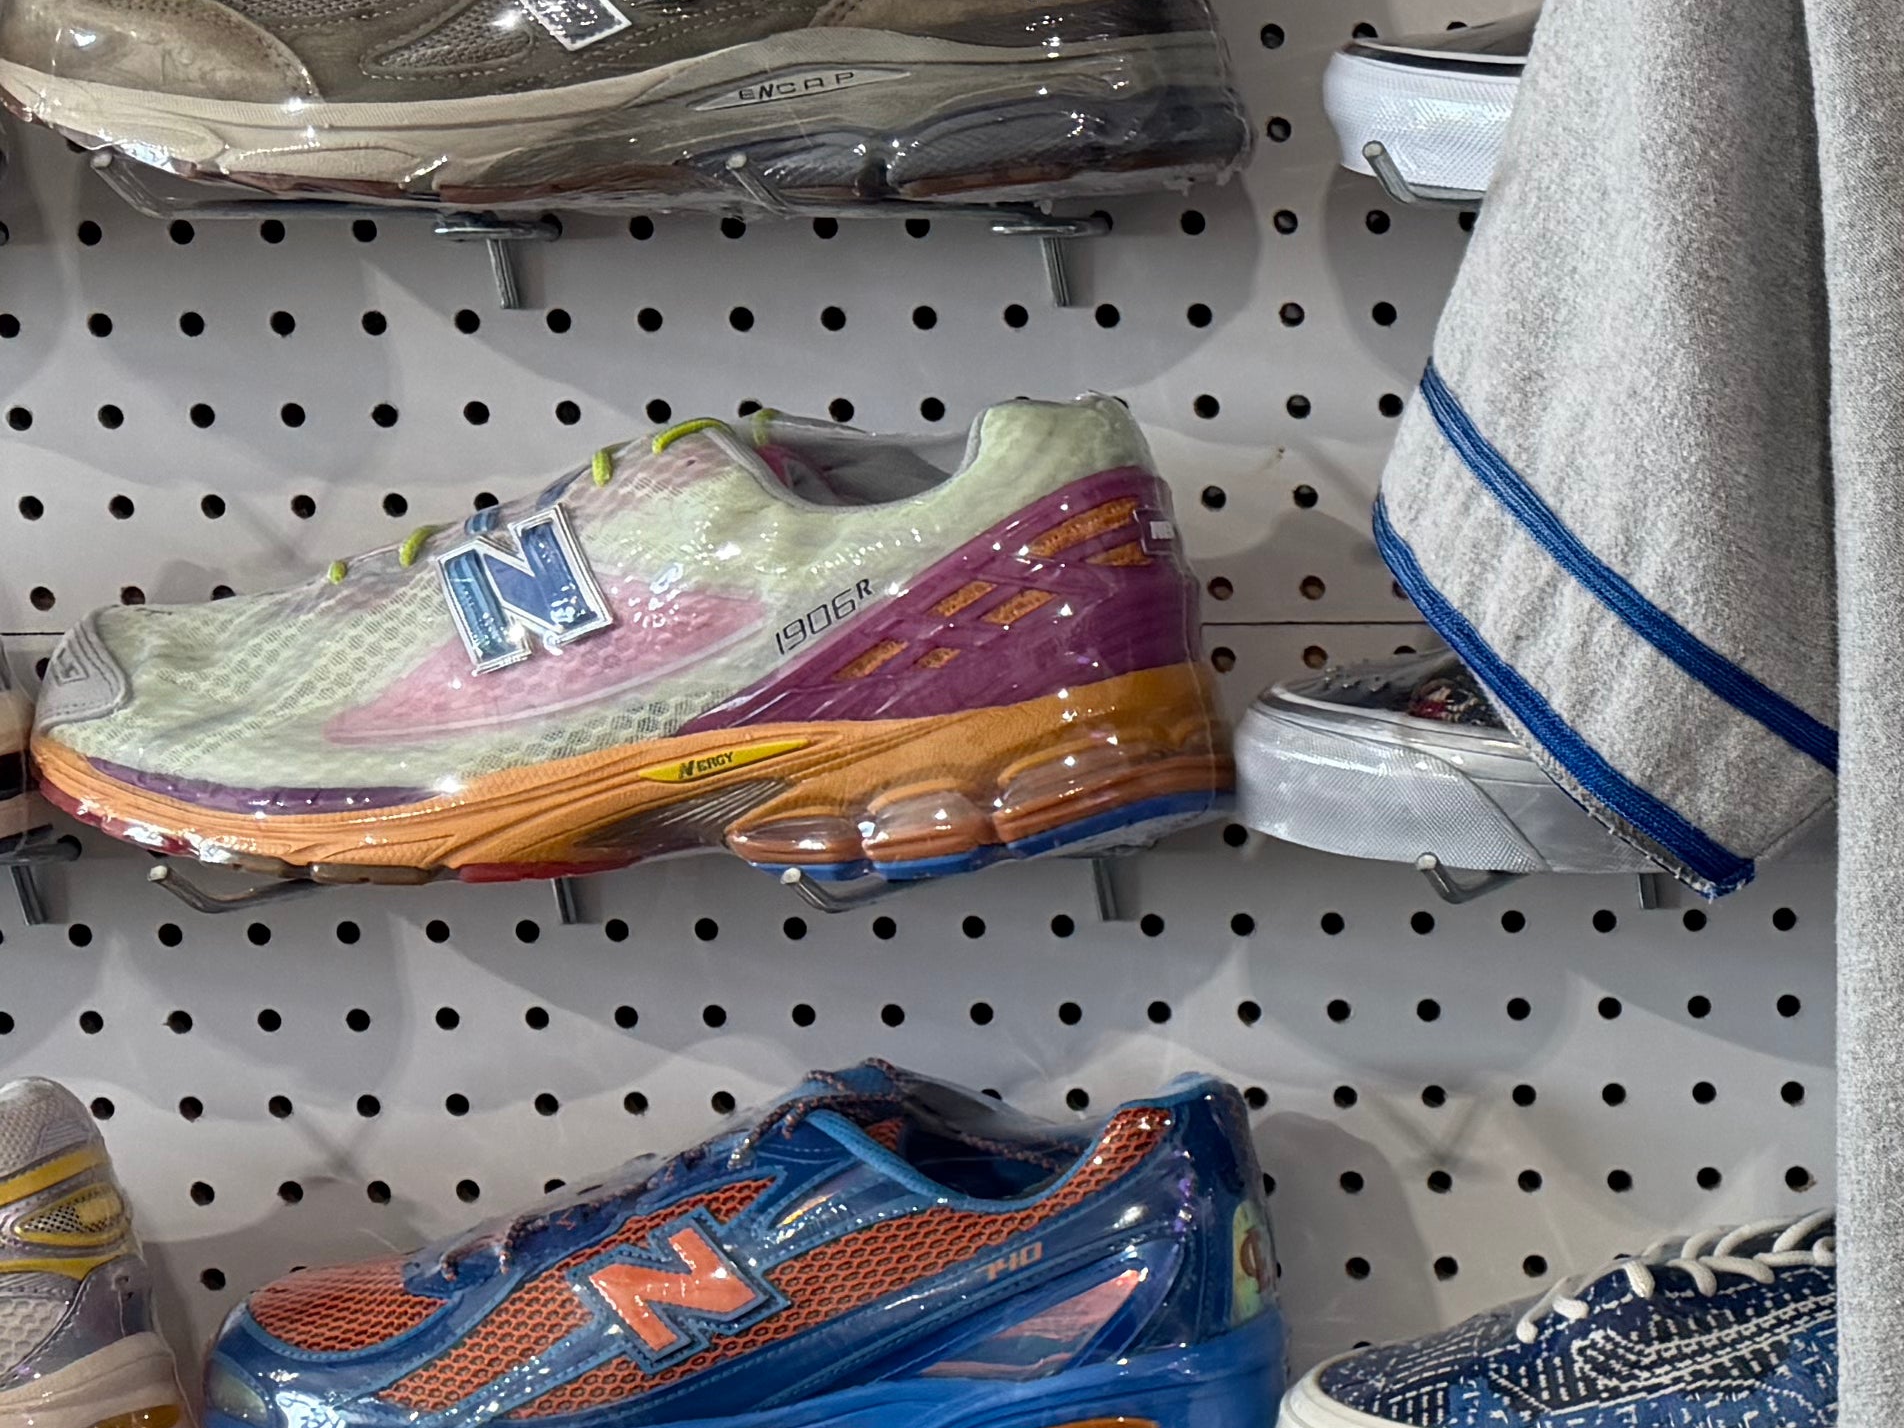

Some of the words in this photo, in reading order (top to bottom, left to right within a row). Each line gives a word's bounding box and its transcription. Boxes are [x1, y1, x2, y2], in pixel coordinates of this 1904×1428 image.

[738, 71, 855, 100] ENCAP
[436, 502, 613, 675] N
[775, 578, 873, 655] 1906R
[678, 751, 734, 779] NERGY
[587, 1226, 758, 1352] N
